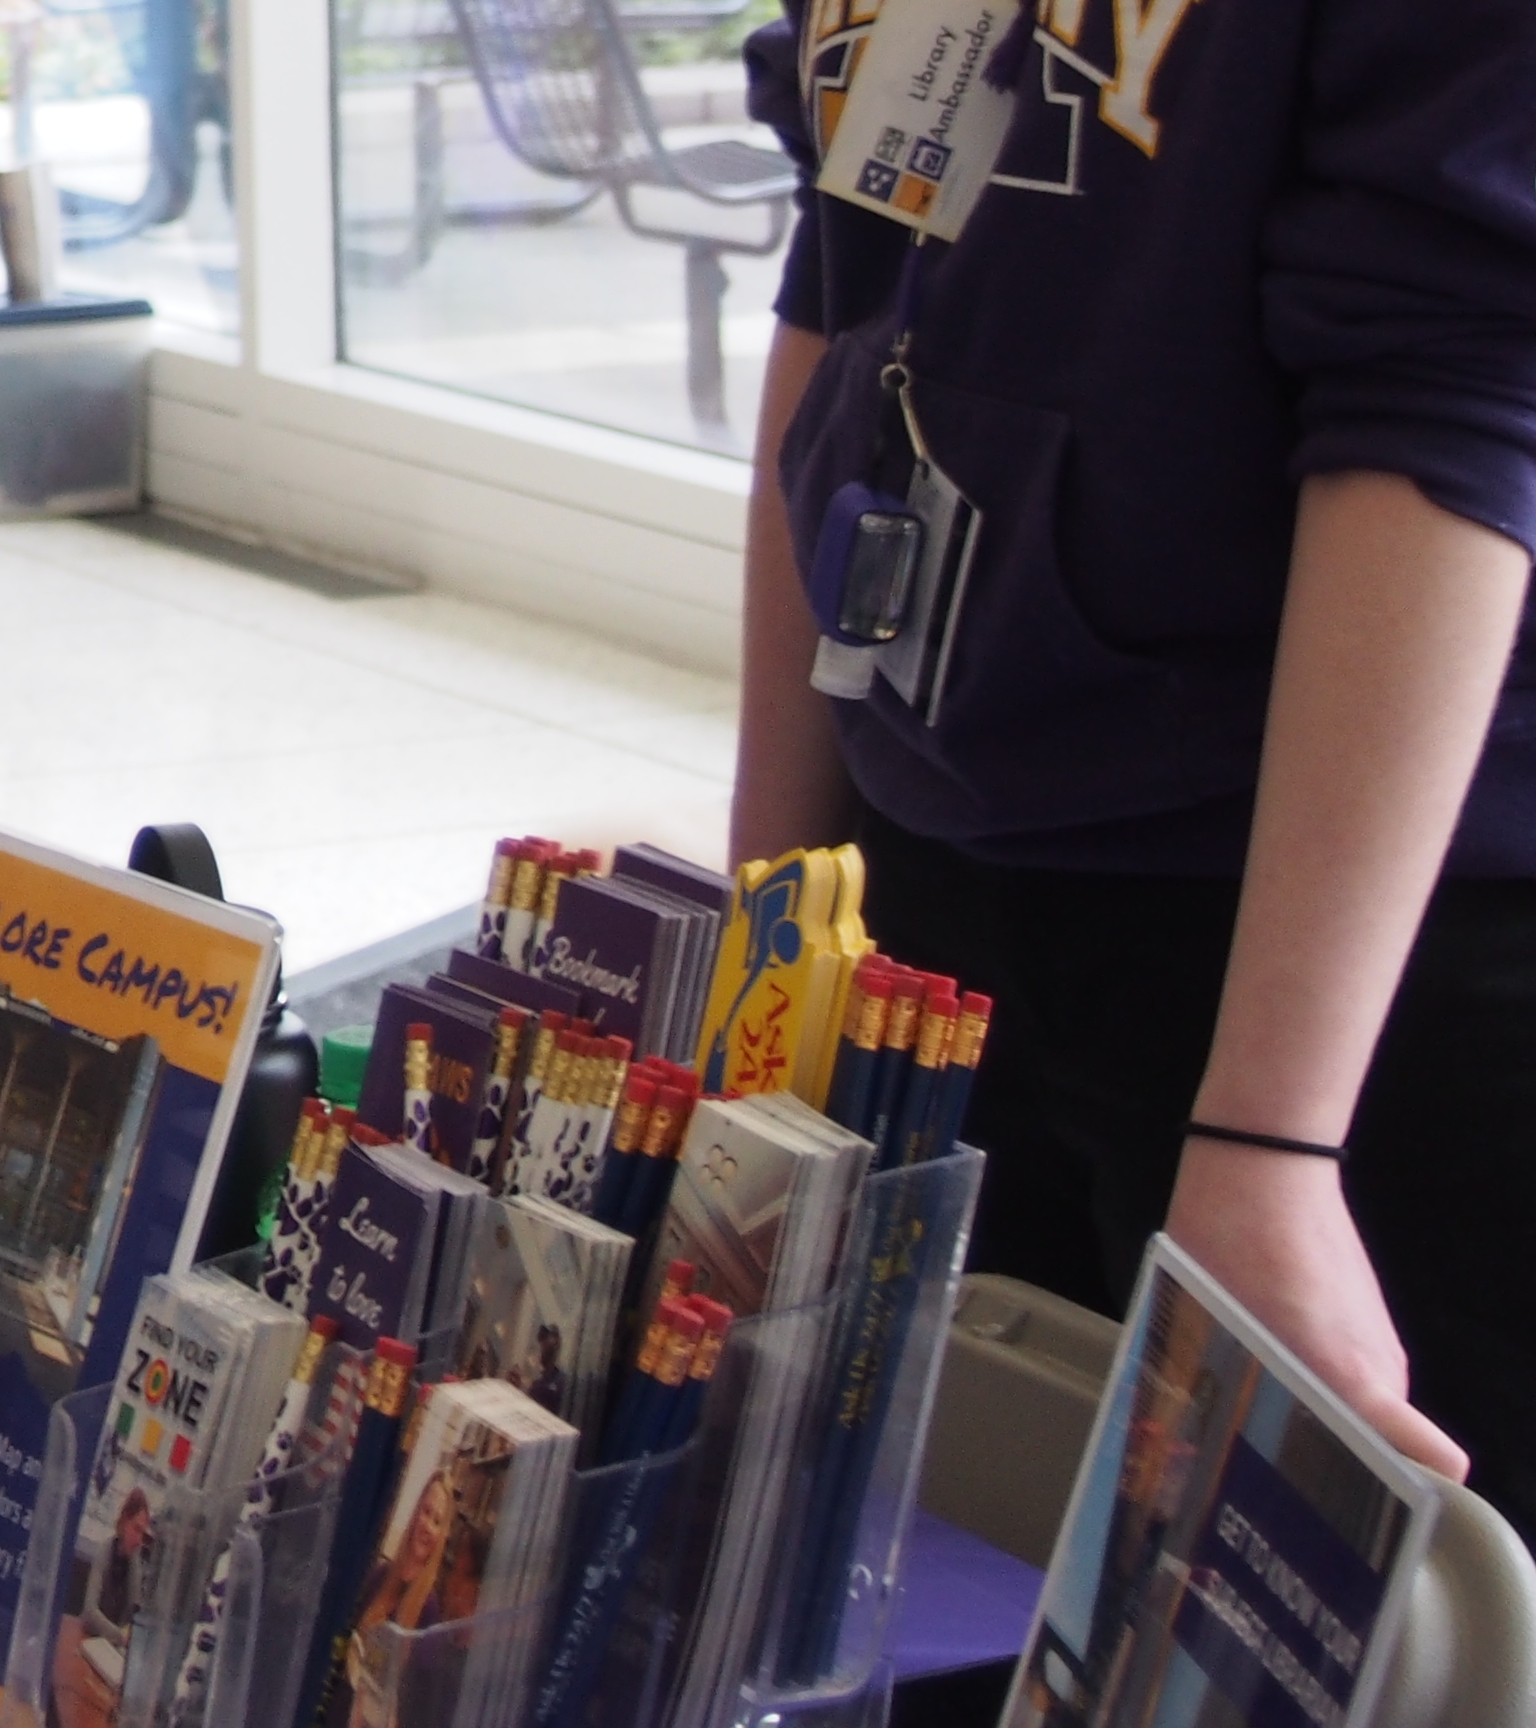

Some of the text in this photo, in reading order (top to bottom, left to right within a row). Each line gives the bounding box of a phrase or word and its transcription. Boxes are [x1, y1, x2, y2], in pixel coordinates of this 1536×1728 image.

[907, 25, 958, 102] Library
[928, 9, 996, 142] Ambassador
[549, 936, 643, 1004] Bookmark
[339, 1197, 398, 1261] Learn
[328, 1265, 382, 1328] to love
[141, 1315, 219, 1374] FIND YOUR
[126, 1348, 208, 1427] ZONE
